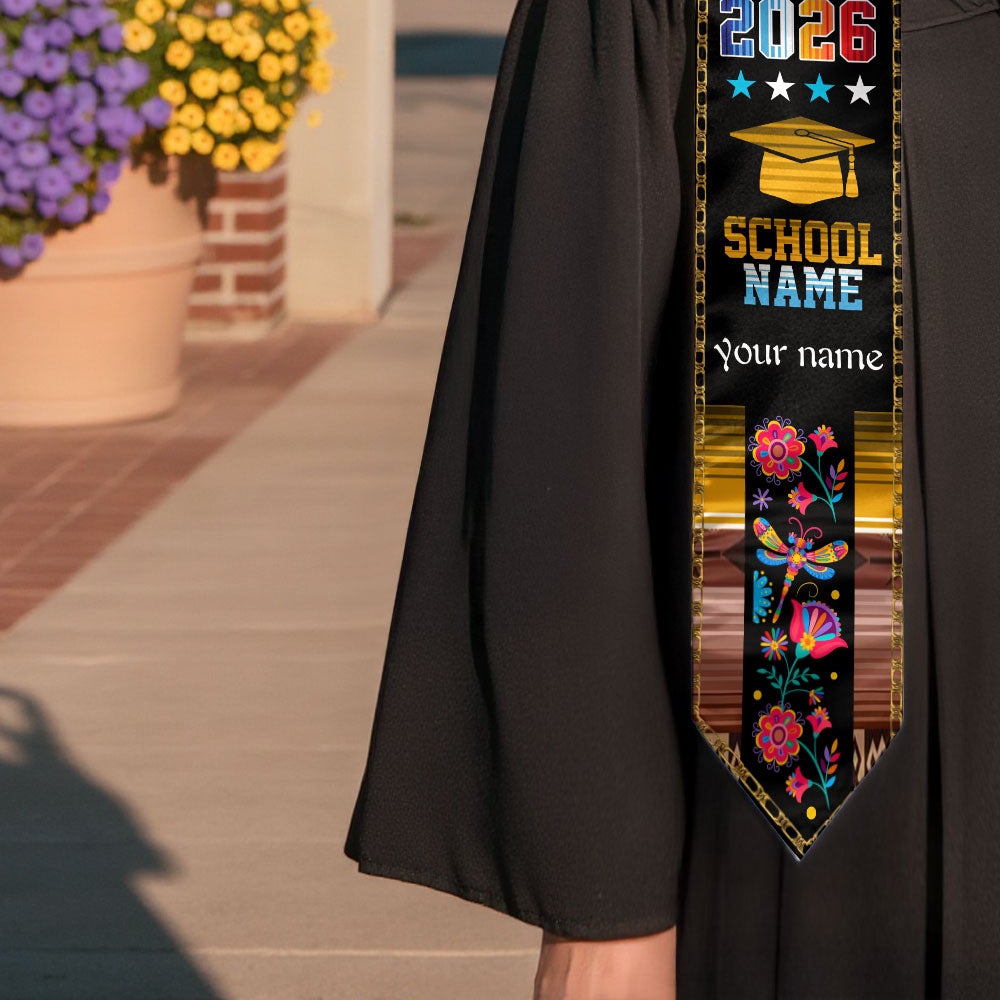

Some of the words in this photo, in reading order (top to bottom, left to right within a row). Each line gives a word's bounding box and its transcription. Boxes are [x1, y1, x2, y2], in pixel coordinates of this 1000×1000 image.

[723, 215, 883, 266] SCHOOL
[743, 263, 864, 311] NAME
[713, 337, 788, 372] your
[797, 345, 884, 371] name
